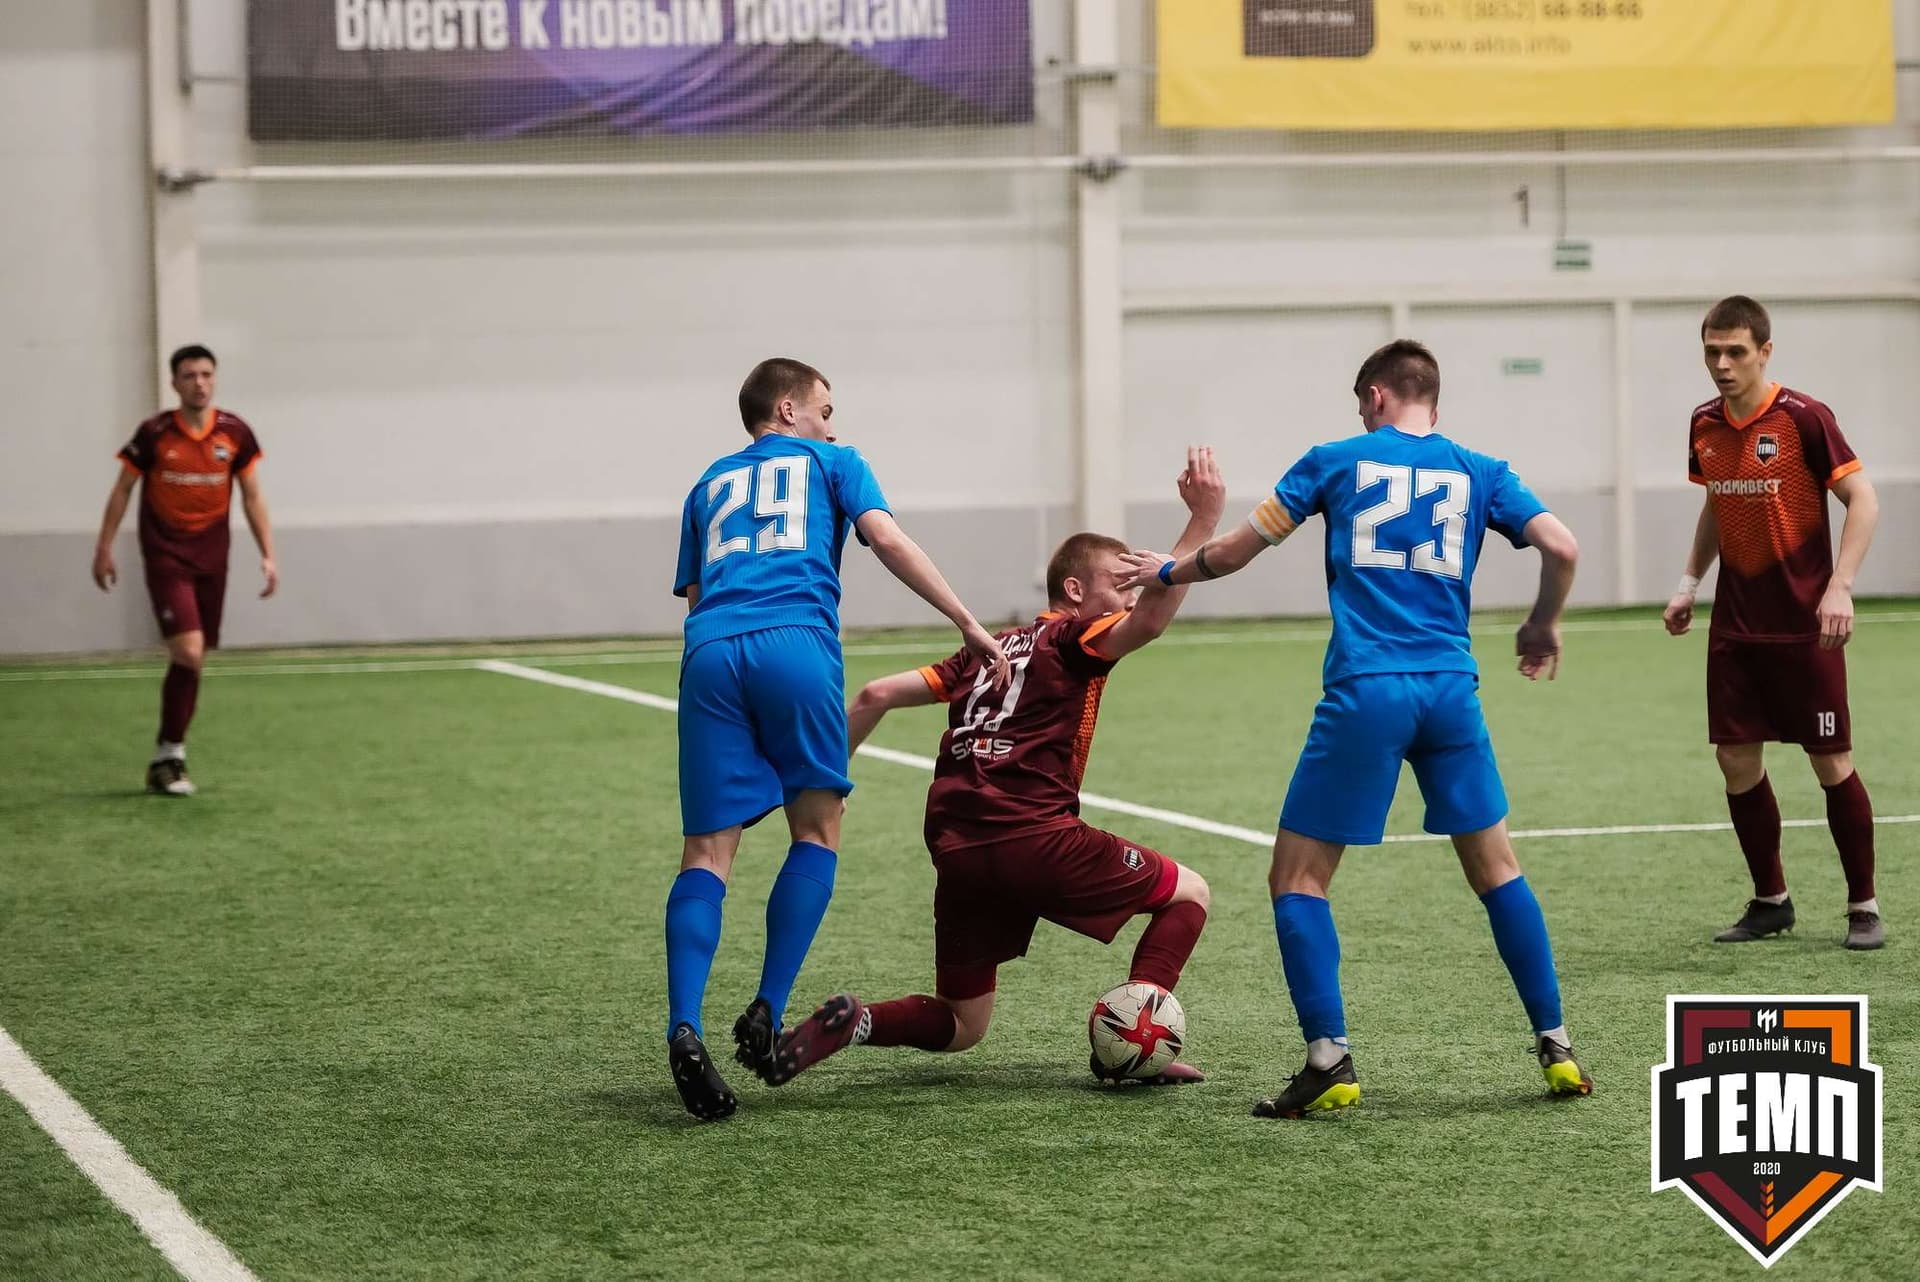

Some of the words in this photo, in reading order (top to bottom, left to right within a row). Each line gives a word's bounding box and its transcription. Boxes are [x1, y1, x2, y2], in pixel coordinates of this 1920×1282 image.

[560, 0, 724, 49] новым
[706, 456, 810, 566] 29
[1352, 460, 1470, 579] 23
[1817, 711, 1836, 737] 19
